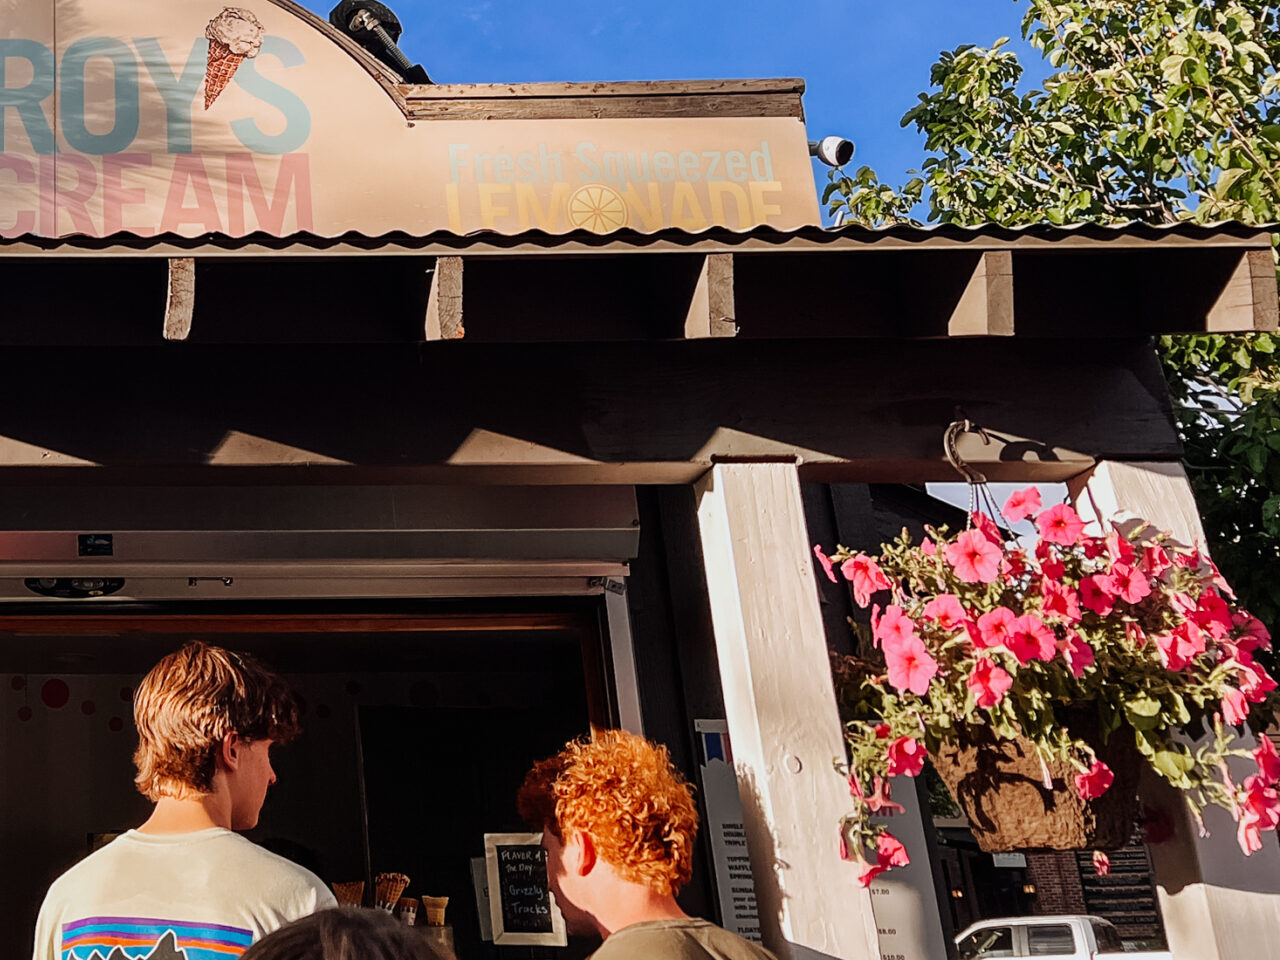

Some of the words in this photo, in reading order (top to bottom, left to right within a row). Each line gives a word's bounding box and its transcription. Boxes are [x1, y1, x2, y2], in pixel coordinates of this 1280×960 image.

[448, 141, 564, 185] Fresh
[575, 141, 775, 192] Squeezed
[509, 885, 544, 900] Grizzly
[512, 902, 548, 915] Tracks
